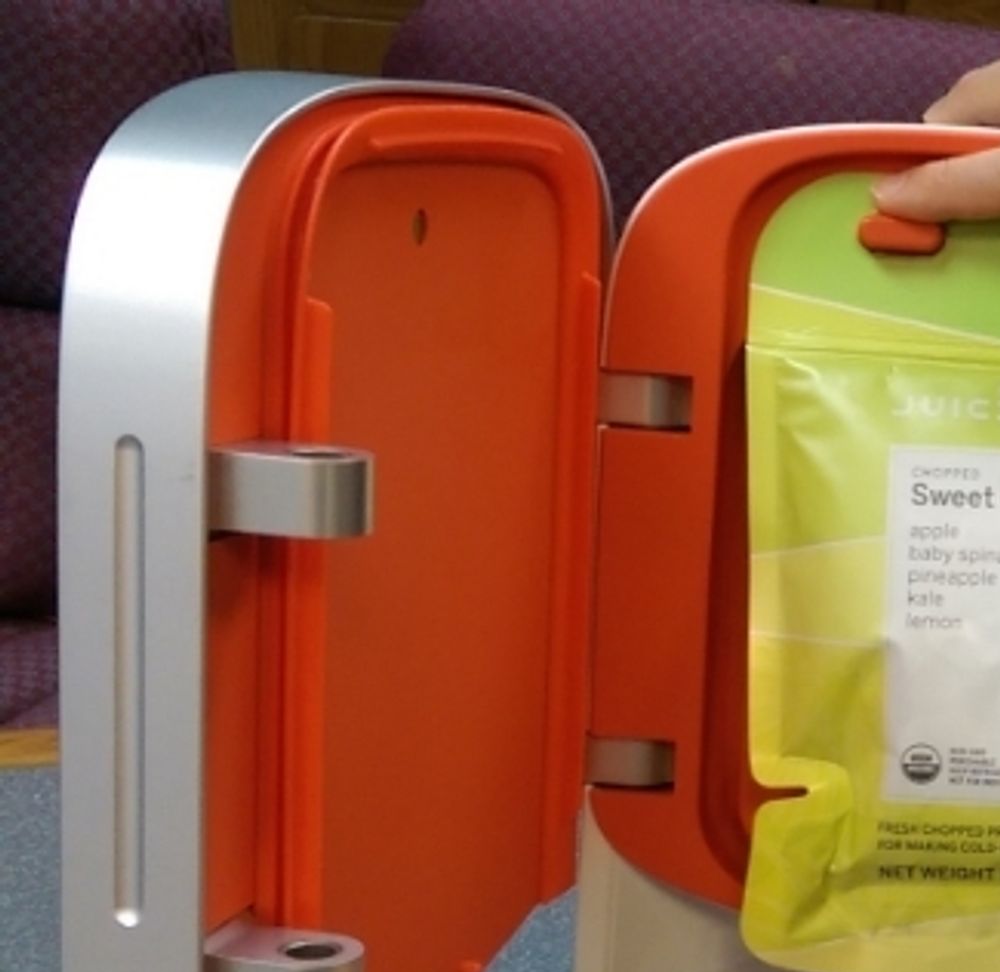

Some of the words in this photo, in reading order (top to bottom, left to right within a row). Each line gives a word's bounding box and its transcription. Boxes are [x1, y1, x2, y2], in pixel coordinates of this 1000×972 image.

[910, 467, 979, 481] CHOPPED
[911, 482, 995, 509] Sweet
[910, 523, 960, 541] apple
[907, 545, 953, 567] baby
[907, 569, 998, 588] pineapple
[907, 589, 944, 608] kale
[905, 612, 962, 629] lemon
[879, 864, 915, 879] NET
[920, 865, 996, 880] WEIGHT
